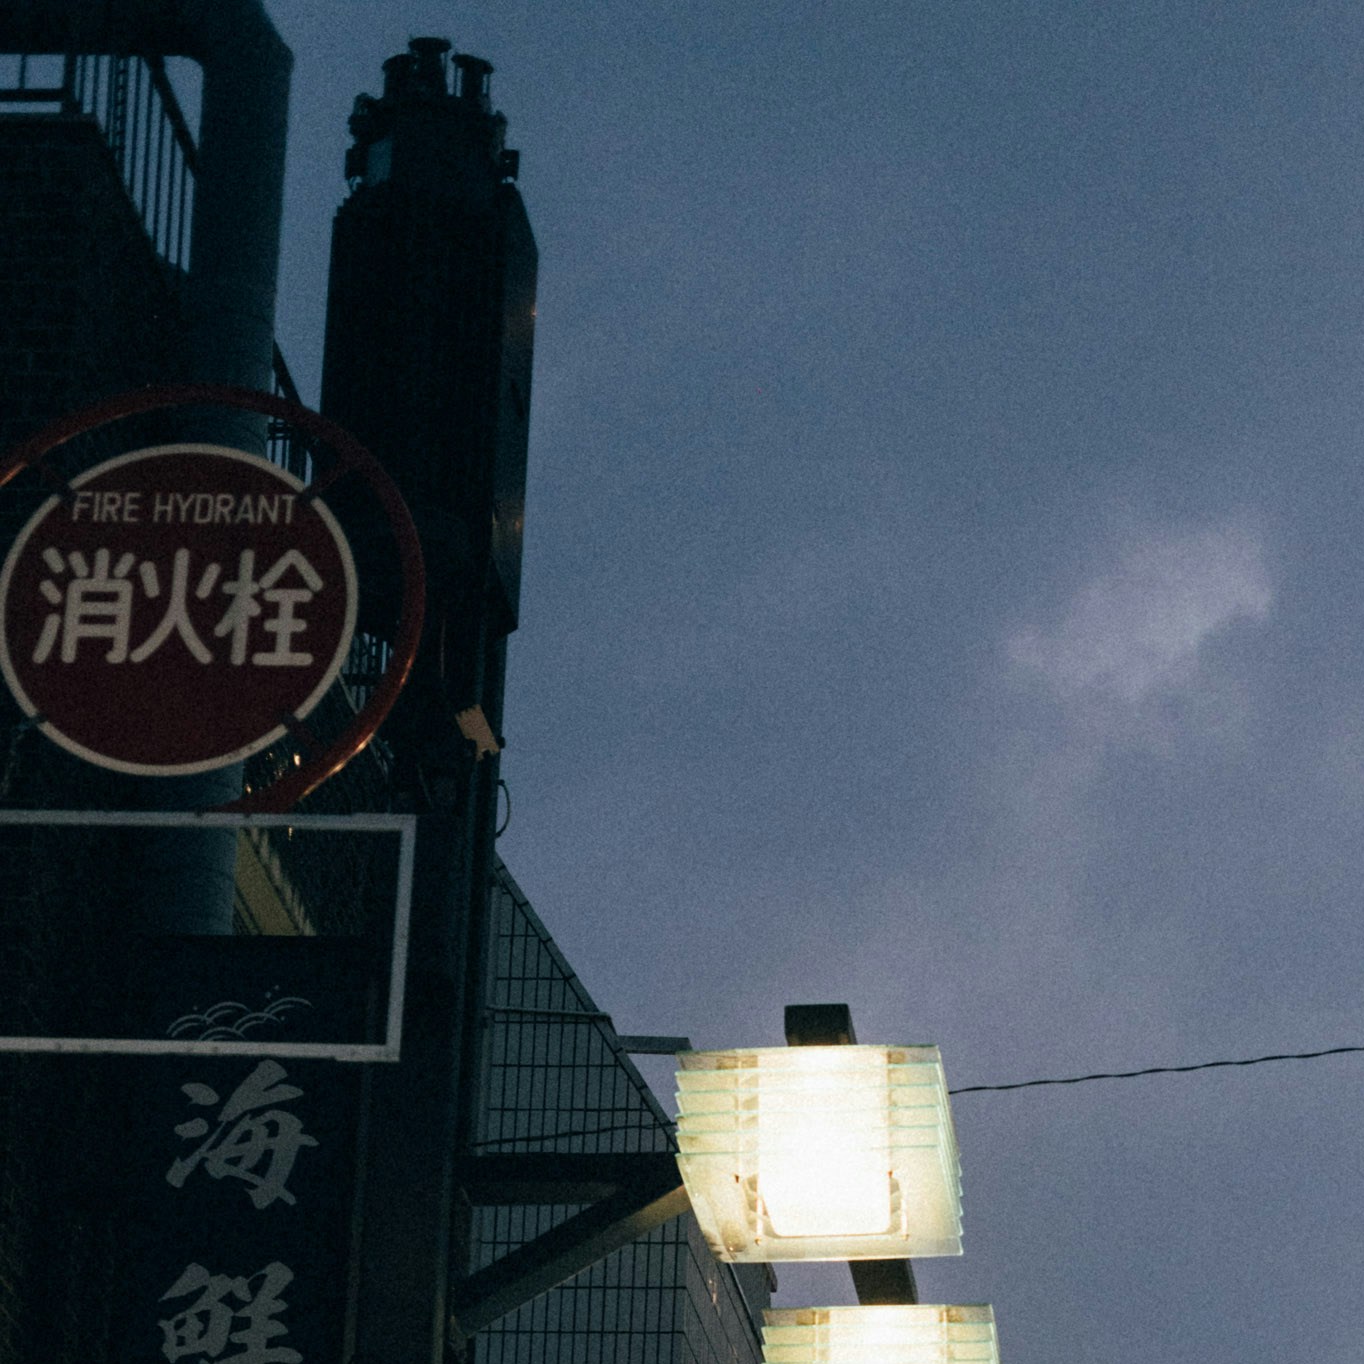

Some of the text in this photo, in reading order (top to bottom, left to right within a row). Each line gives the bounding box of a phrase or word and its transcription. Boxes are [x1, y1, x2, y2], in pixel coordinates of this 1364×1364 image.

[70, 491, 297, 526] FIRE HYDRANT
[32, 547, 323, 667] 消火栓
